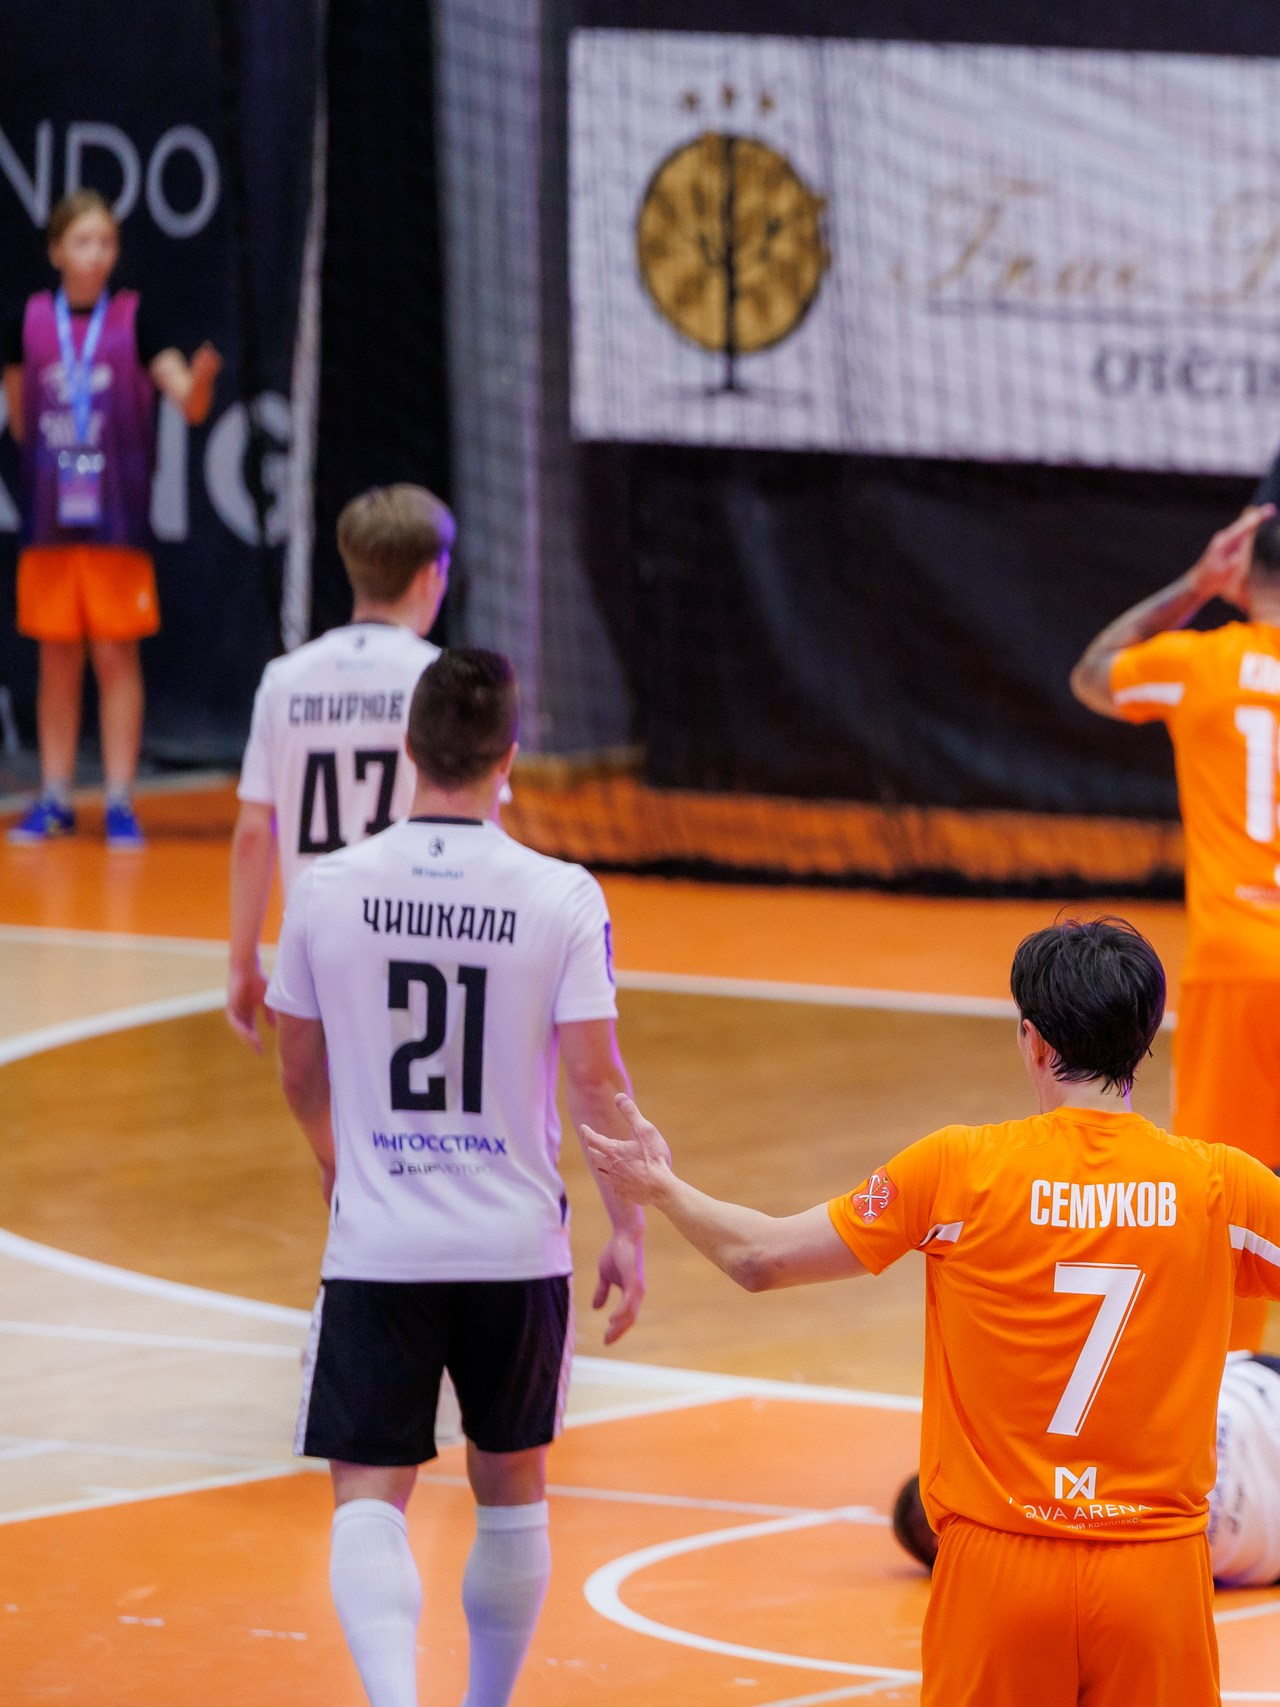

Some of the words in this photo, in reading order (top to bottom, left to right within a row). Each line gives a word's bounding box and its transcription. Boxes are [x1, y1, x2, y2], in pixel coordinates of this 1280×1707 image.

[363, 898, 517, 944] ЧИШКАЛА
[387, 960, 487, 1114] 21
[372, 1131, 507, 1155] ИНГОССТРАХ
[1030, 1179, 1178, 1229] СЕМУКОВ
[1047, 1261, 1146, 1437] 7
[1073, 1504, 1153, 1520] ARENA
